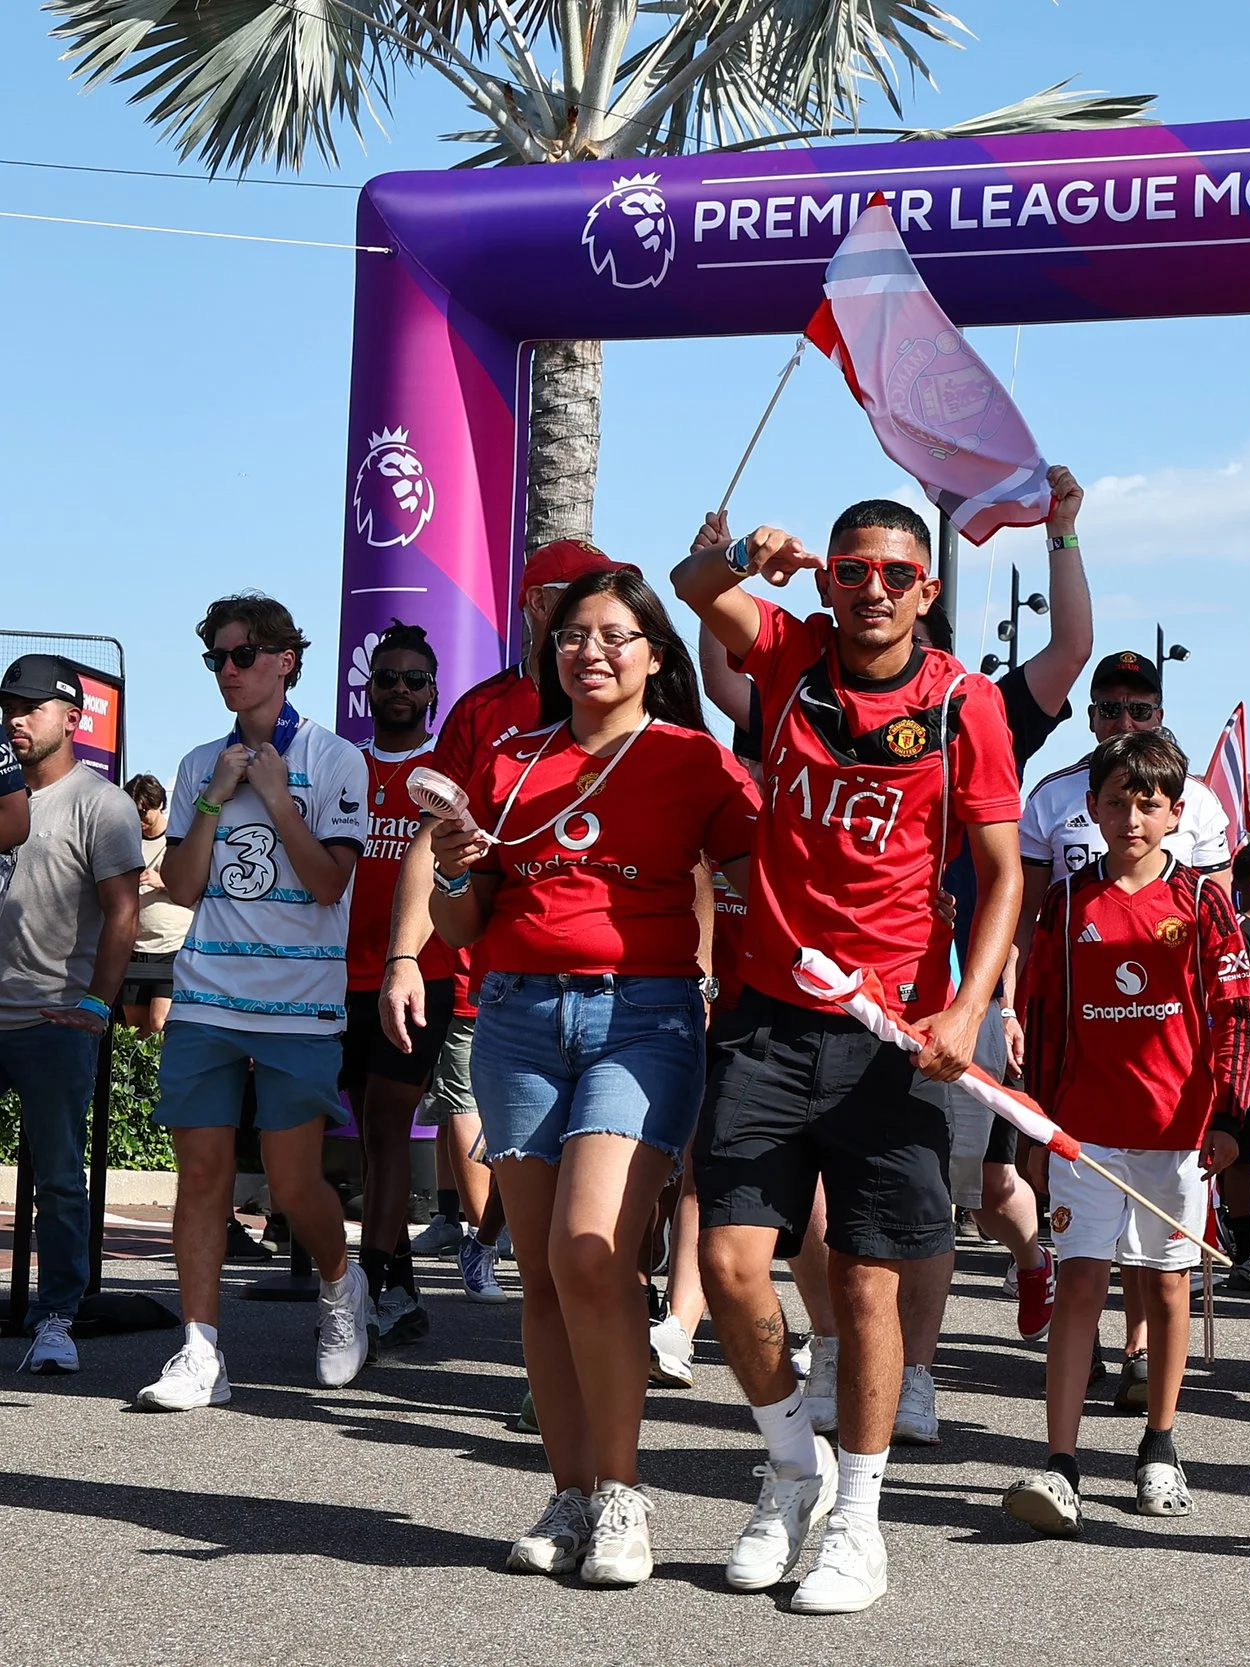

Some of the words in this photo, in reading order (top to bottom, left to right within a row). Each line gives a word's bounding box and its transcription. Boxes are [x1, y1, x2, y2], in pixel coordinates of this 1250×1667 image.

[949, 174, 1177, 230] LEAGUE
[367, 811, 421, 838] irate
[220, 823, 278, 901] 3
[1082, 1002, 1184, 1023] Snapdragon
